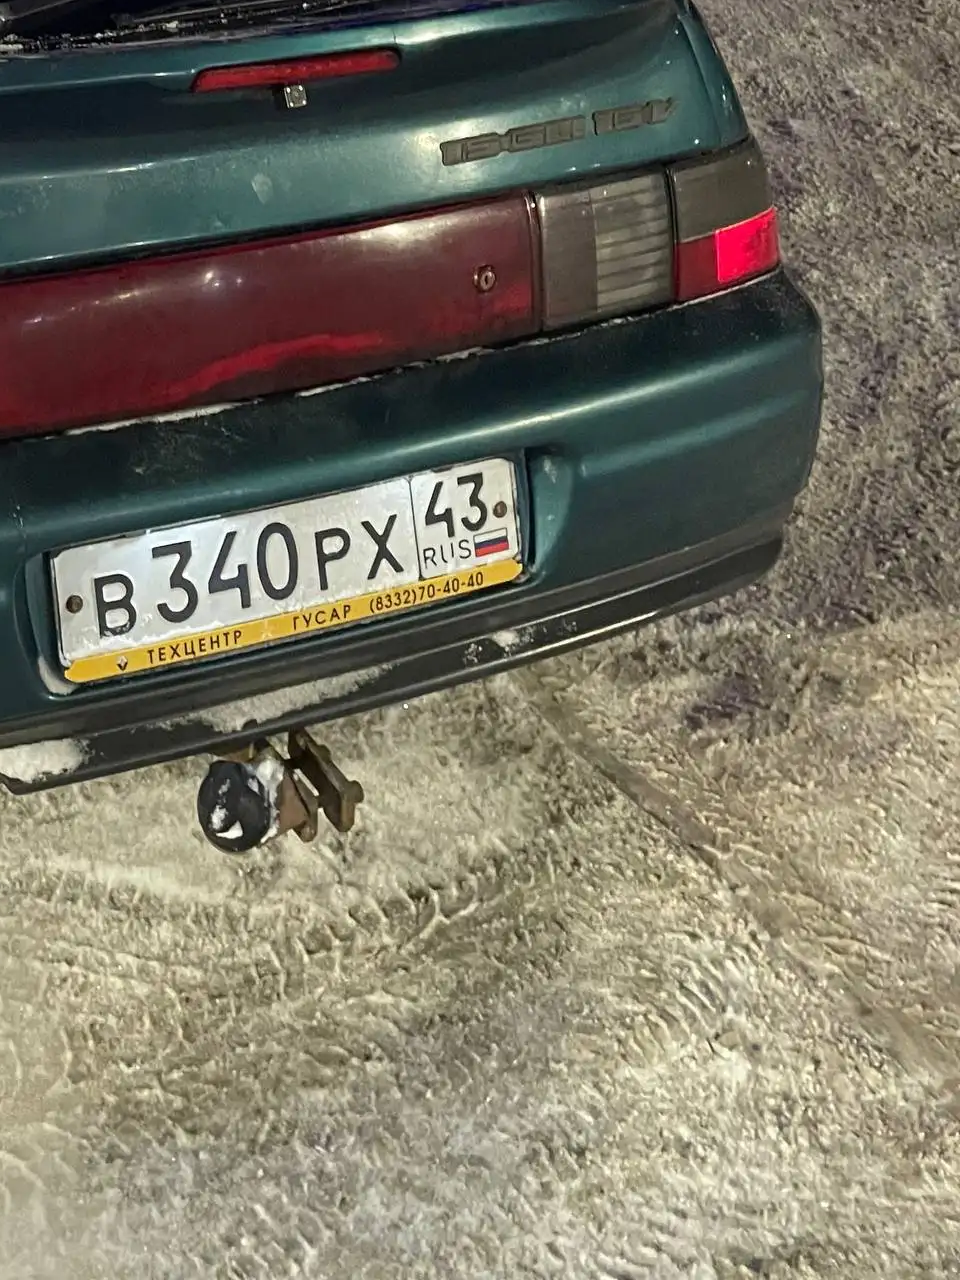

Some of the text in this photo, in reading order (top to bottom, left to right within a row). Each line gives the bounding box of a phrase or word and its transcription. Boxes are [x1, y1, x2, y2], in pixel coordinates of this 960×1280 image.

[93, 471, 488, 639] В340РХ 43
[423, 538, 473, 569] RUS
[147, 630, 243, 665] ТЕХЦЕНТР
[292, 604, 352, 631] ГУСАР
